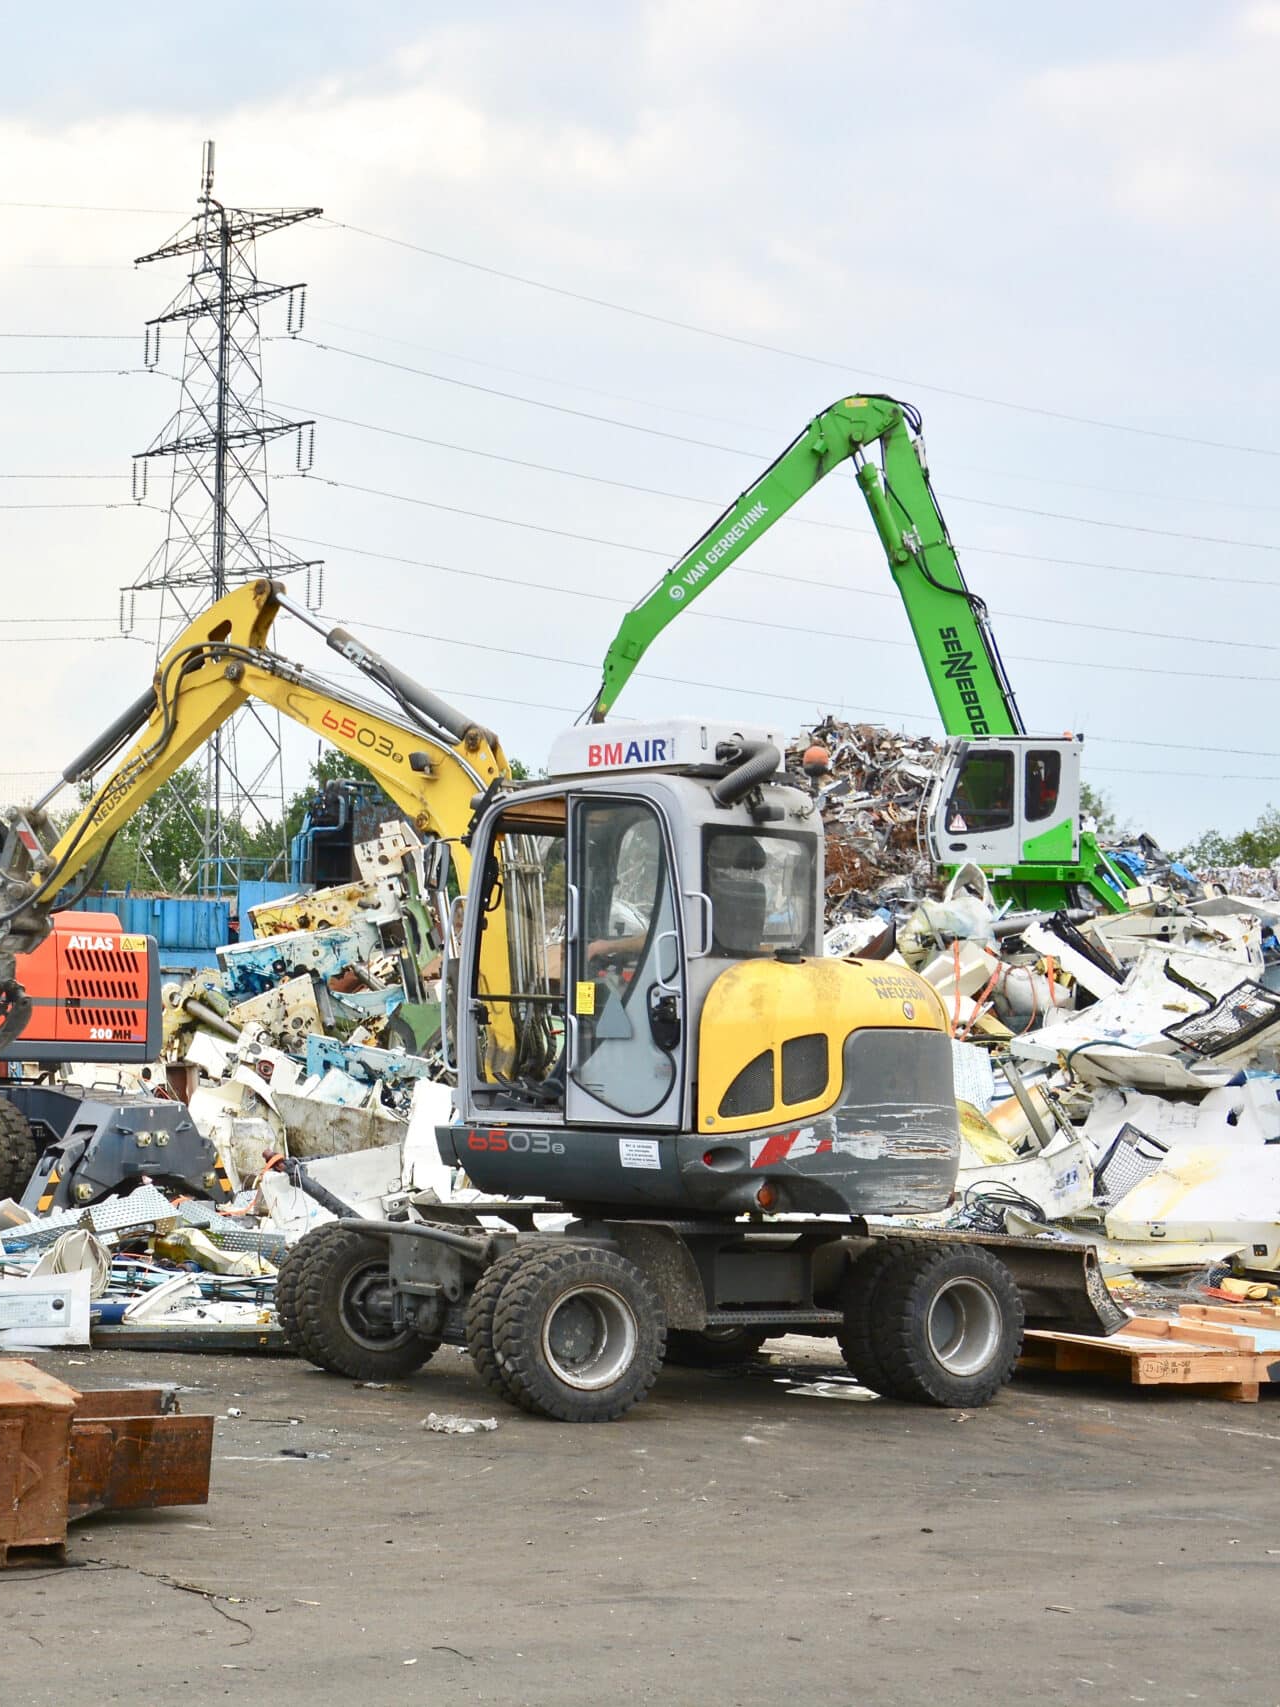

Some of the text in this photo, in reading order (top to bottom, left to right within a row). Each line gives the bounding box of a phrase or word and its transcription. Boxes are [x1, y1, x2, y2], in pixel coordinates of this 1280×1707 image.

[682, 501, 769, 585] VAN GERREVINK
[588, 738, 666, 767] BMAIR
[67, 935, 114, 951] ATLAS
